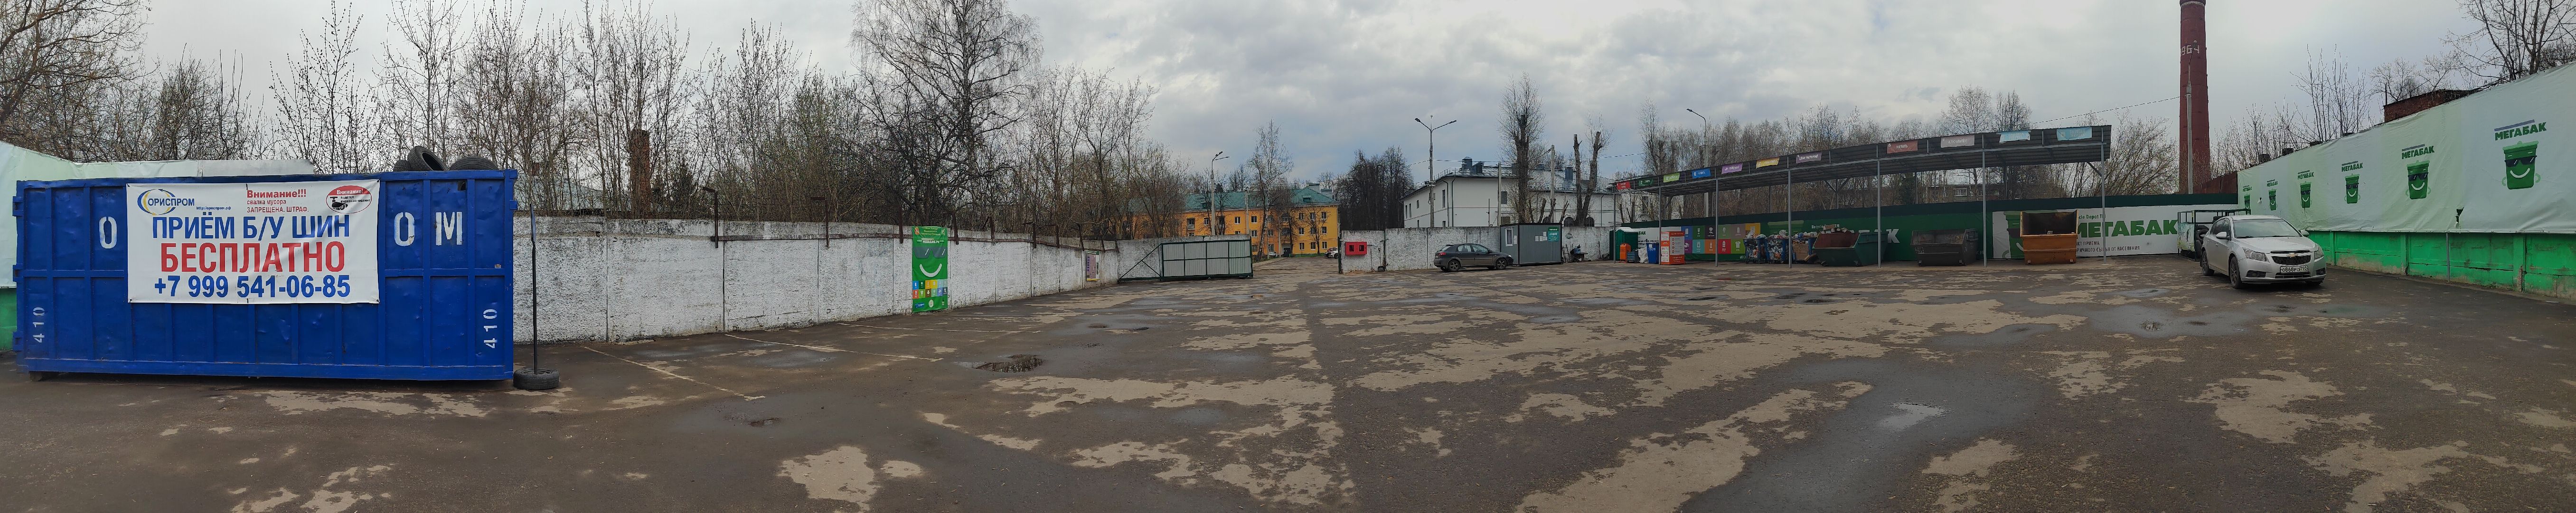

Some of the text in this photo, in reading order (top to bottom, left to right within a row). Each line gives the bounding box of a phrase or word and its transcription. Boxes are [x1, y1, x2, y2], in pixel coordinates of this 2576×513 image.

[2495, 122, 2547, 141] МЕГАБАК
[2401, 145, 2435, 159] МЕГАБАК
[2297, 171, 2314, 180] МЕГАБАК
[2341, 162, 2363, 172] МЕГАБАК
[148, 198, 195, 206] ОРИСПРОМ
[247, 189, 307, 198] Внимание!!!
[152, 211, 349, 241] ПРИЁМ Б/У ШИН
[161, 241, 345, 273] БЕСПЛАТНО
[154, 275, 350, 298] +7 999 541-06-85
[33, 307, 45, 343] 410
[483, 308, 498, 349] 410
